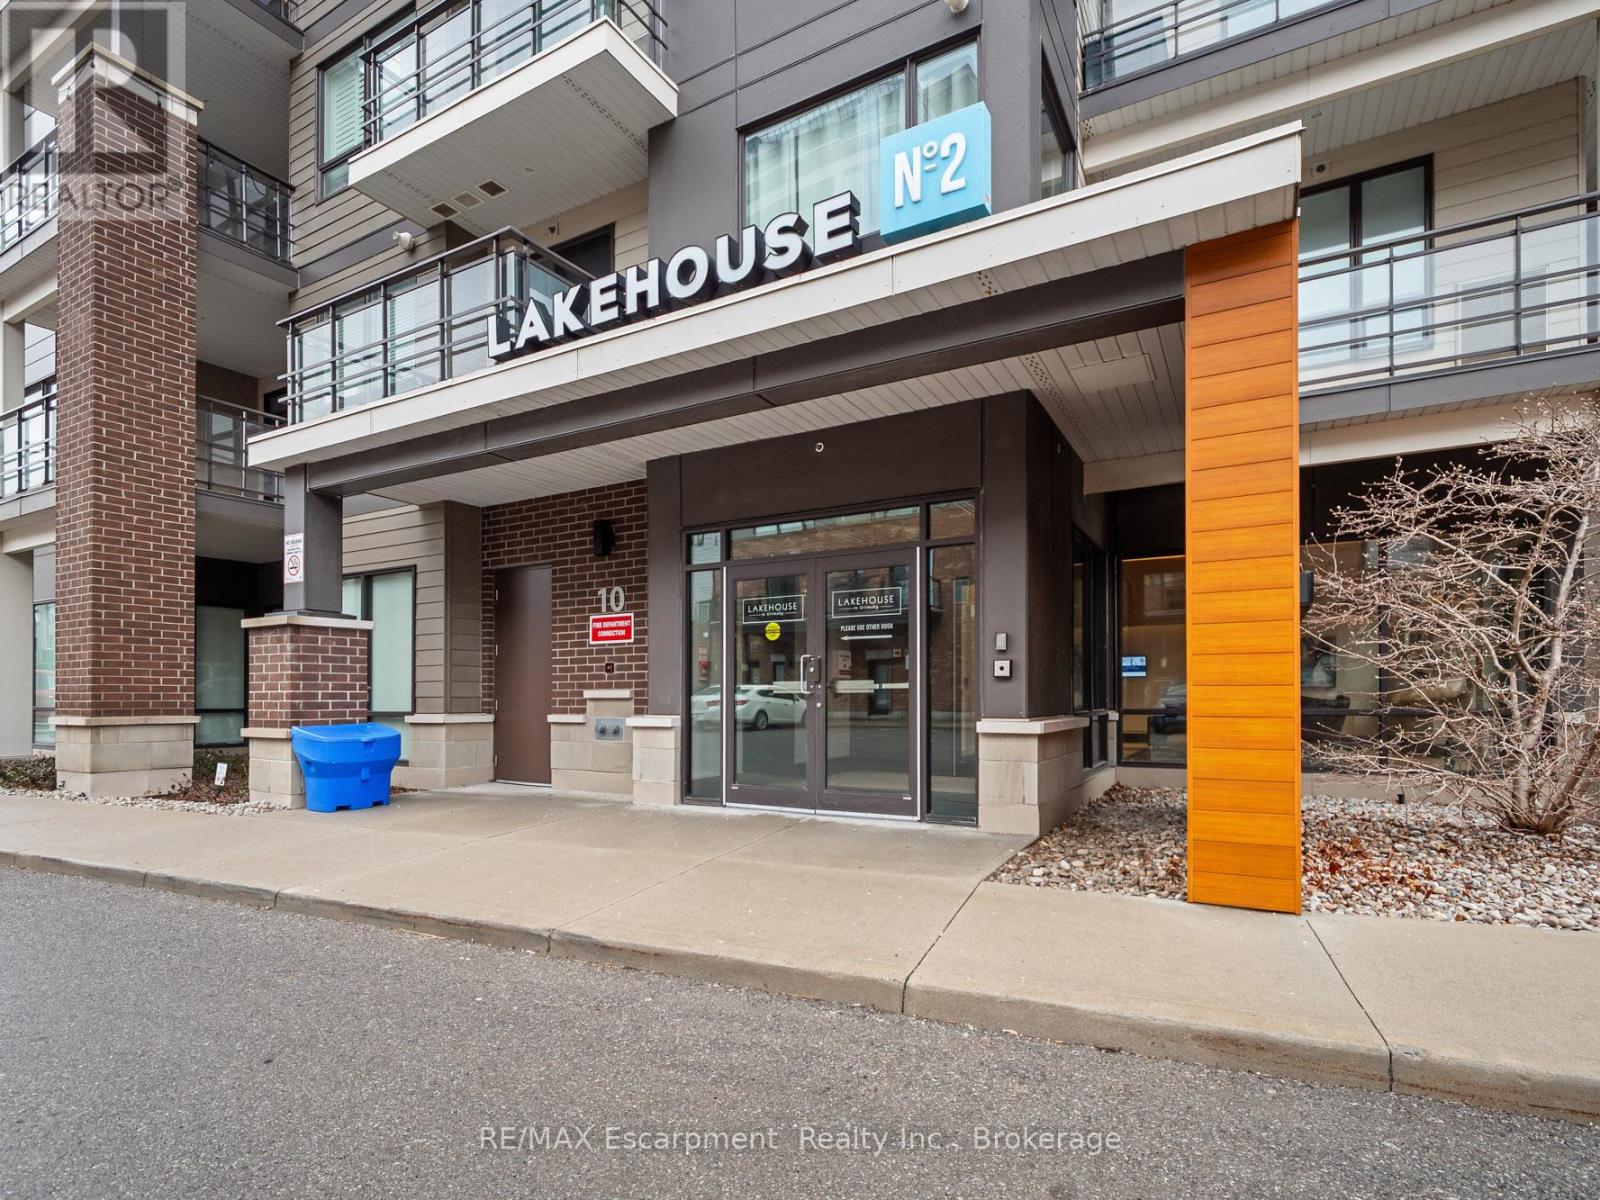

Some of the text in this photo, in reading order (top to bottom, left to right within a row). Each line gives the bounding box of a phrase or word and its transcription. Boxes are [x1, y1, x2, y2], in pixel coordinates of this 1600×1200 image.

[487, 191, 855, 360] LAKEHOUSE
[597, 586, 625, 613] 10
[838, 595, 895, 607] LAKEHOUSE
[747, 602, 798, 613] LAKEHOUSE
[603, 620, 631, 628] DEPARTMENT
[866, 623, 880, 631] OTHER
[881, 622, 894, 630] DOOR
[597, 629, 626, 637] CONNECTION
